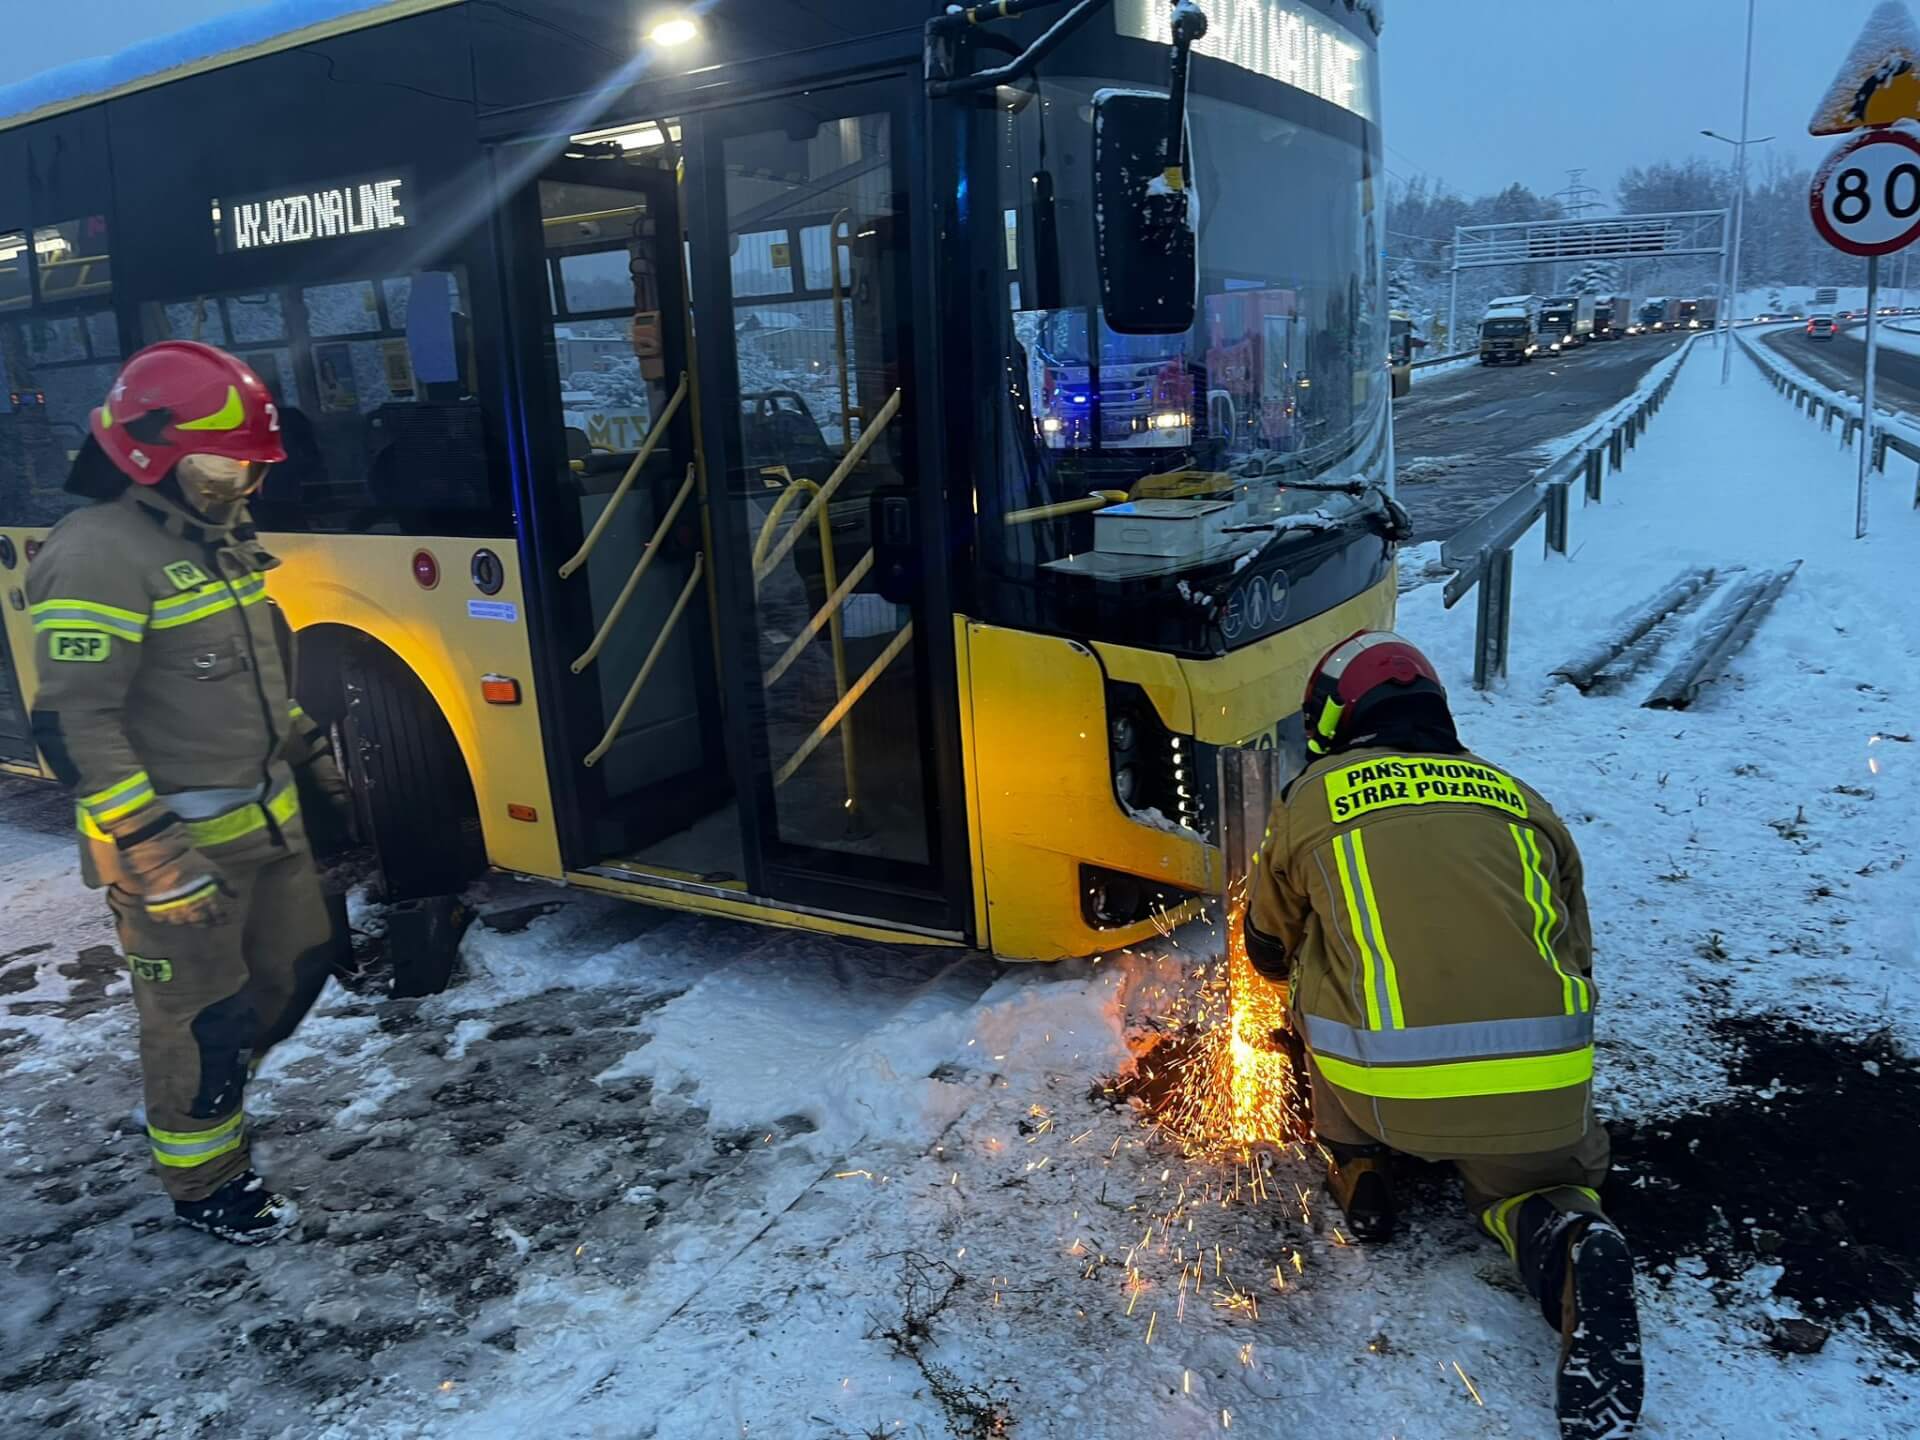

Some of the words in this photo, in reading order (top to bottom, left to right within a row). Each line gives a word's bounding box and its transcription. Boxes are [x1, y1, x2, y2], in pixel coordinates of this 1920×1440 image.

[1833, 163, 1920, 224] 80
[234, 195, 313, 248] WYJAZD
[314, 189, 346, 237] NA
[59, 637, 101, 656] PSP
[1347, 762, 1502, 788] PAŃSTWOWA
[1335, 780, 1410, 816] STRAŻ
[1416, 781, 1524, 811] POŻARNA
